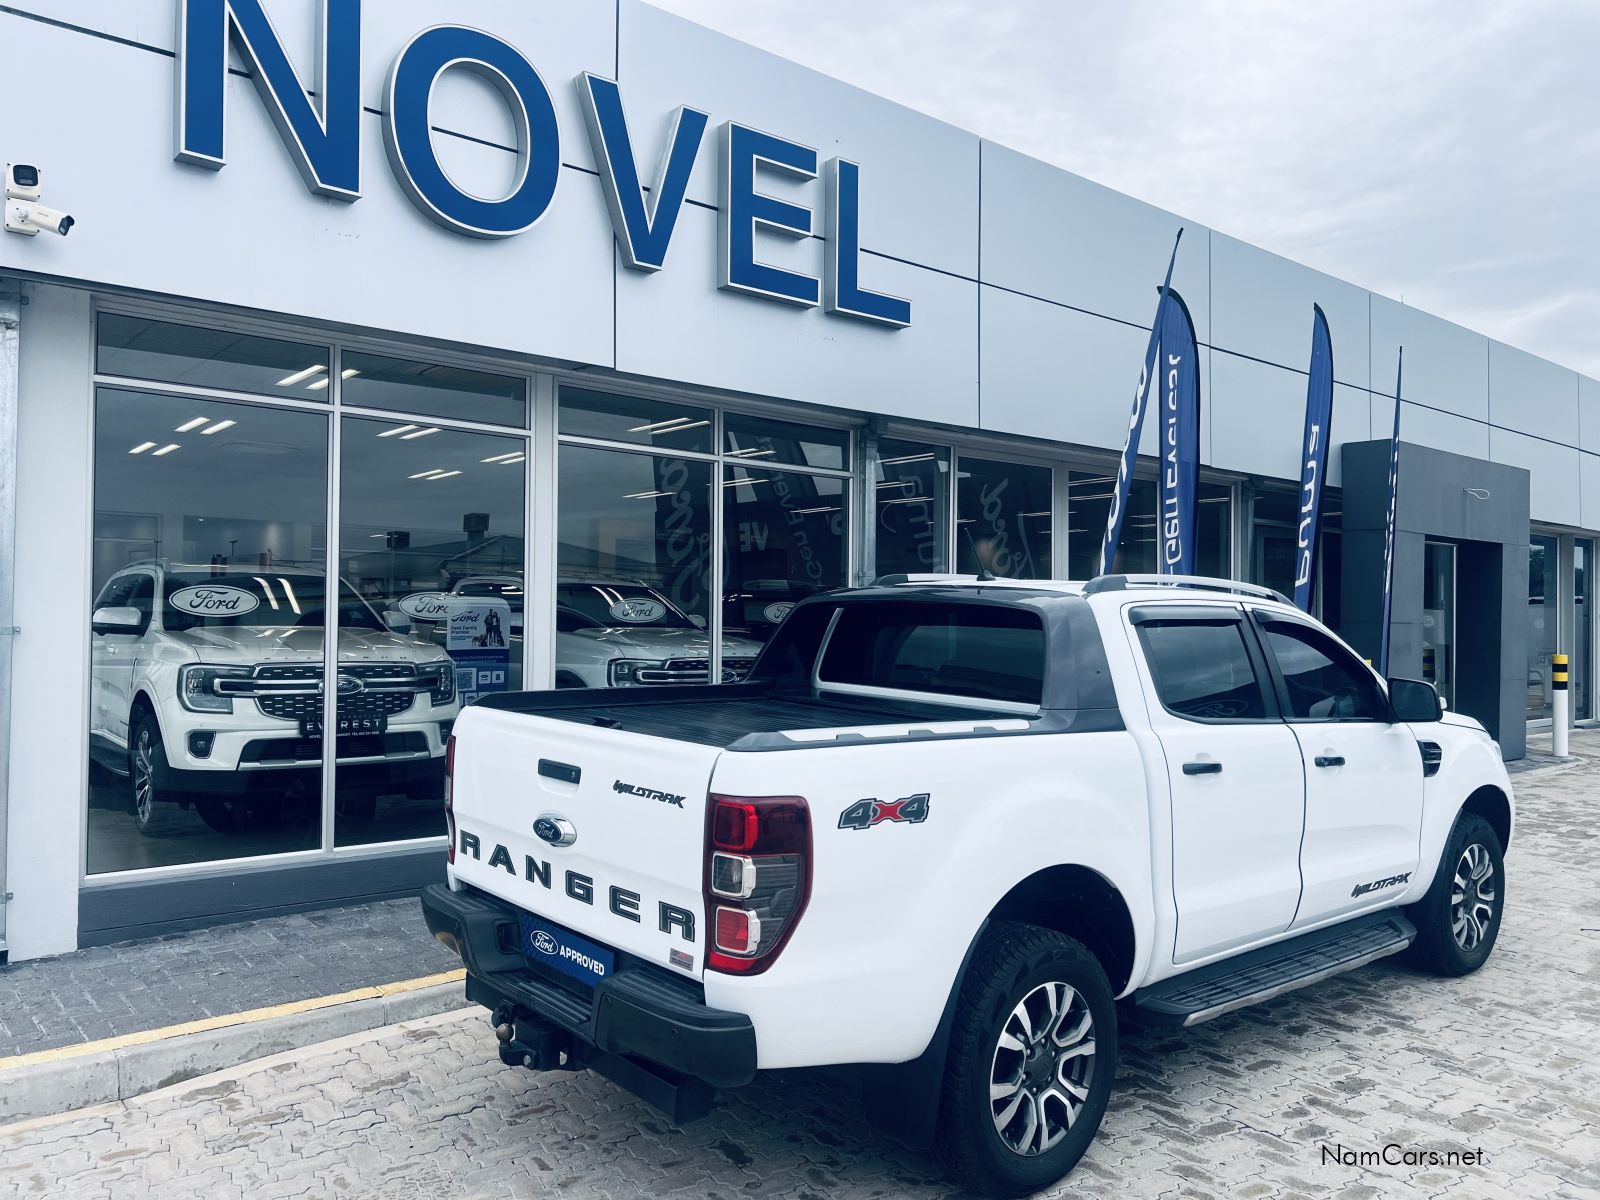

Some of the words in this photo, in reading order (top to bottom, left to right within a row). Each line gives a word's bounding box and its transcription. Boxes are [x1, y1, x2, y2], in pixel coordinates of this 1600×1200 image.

[173, 0, 911, 330] NOVEL
[189, 589, 240, 609] Ford
[622, 602, 654, 617] Ford
[612, 779, 687, 809] WILDTRAK
[536, 821, 555, 839] Ford
[460, 829, 696, 943] RANGER
[1350, 871, 1412, 898] WILDTRAK
[535, 932, 554, 953] Ford
[559, 945, 605, 976] APPROVED
